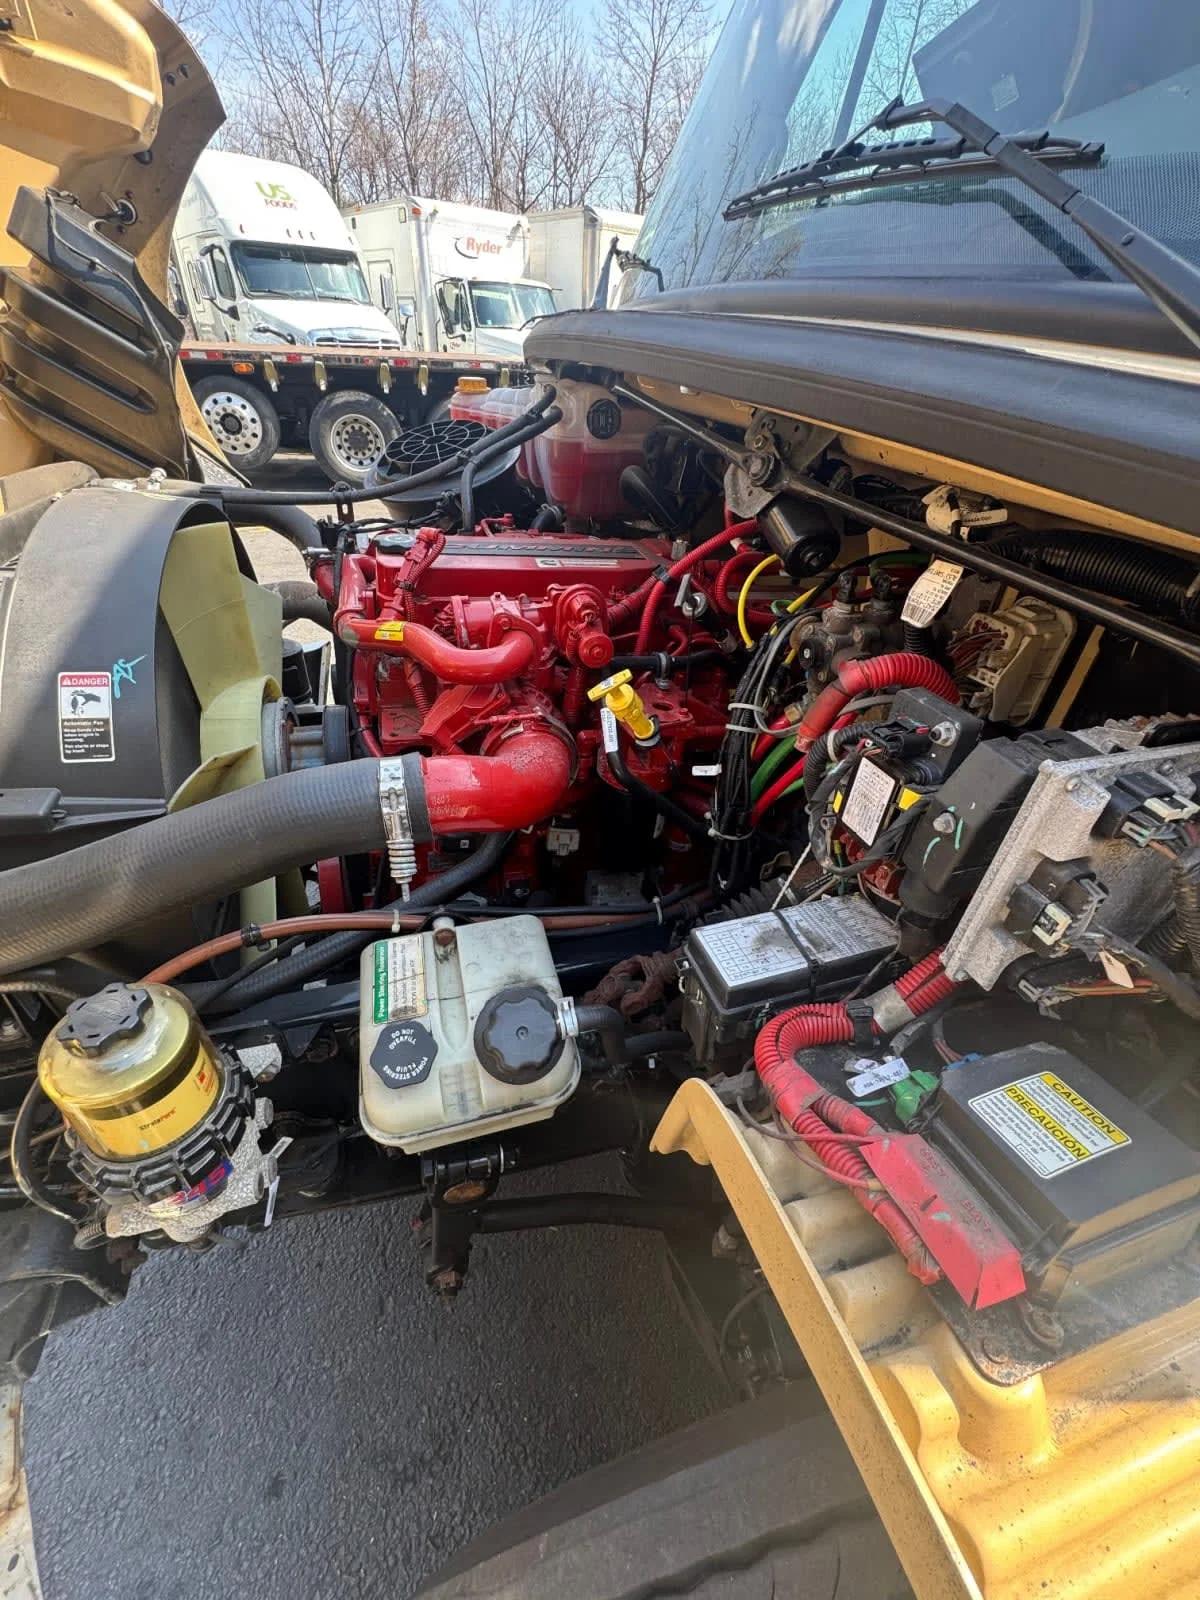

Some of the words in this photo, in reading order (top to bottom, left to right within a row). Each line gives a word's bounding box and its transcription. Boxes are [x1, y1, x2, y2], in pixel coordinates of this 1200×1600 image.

[255, 181, 291, 200] US
[466, 237, 502, 255] Ryder
[71, 677, 108, 686] DANGER
[388, 1035, 417, 1050] OVERFILL
[391, 1031, 400, 1039] DO
[383, 1064, 411, 1080] STEERING
[395, 1062, 416, 1073] FLUID
[411, 1056, 428, 1077] POWER
[1050, 1082, 1116, 1134] CAUTION
